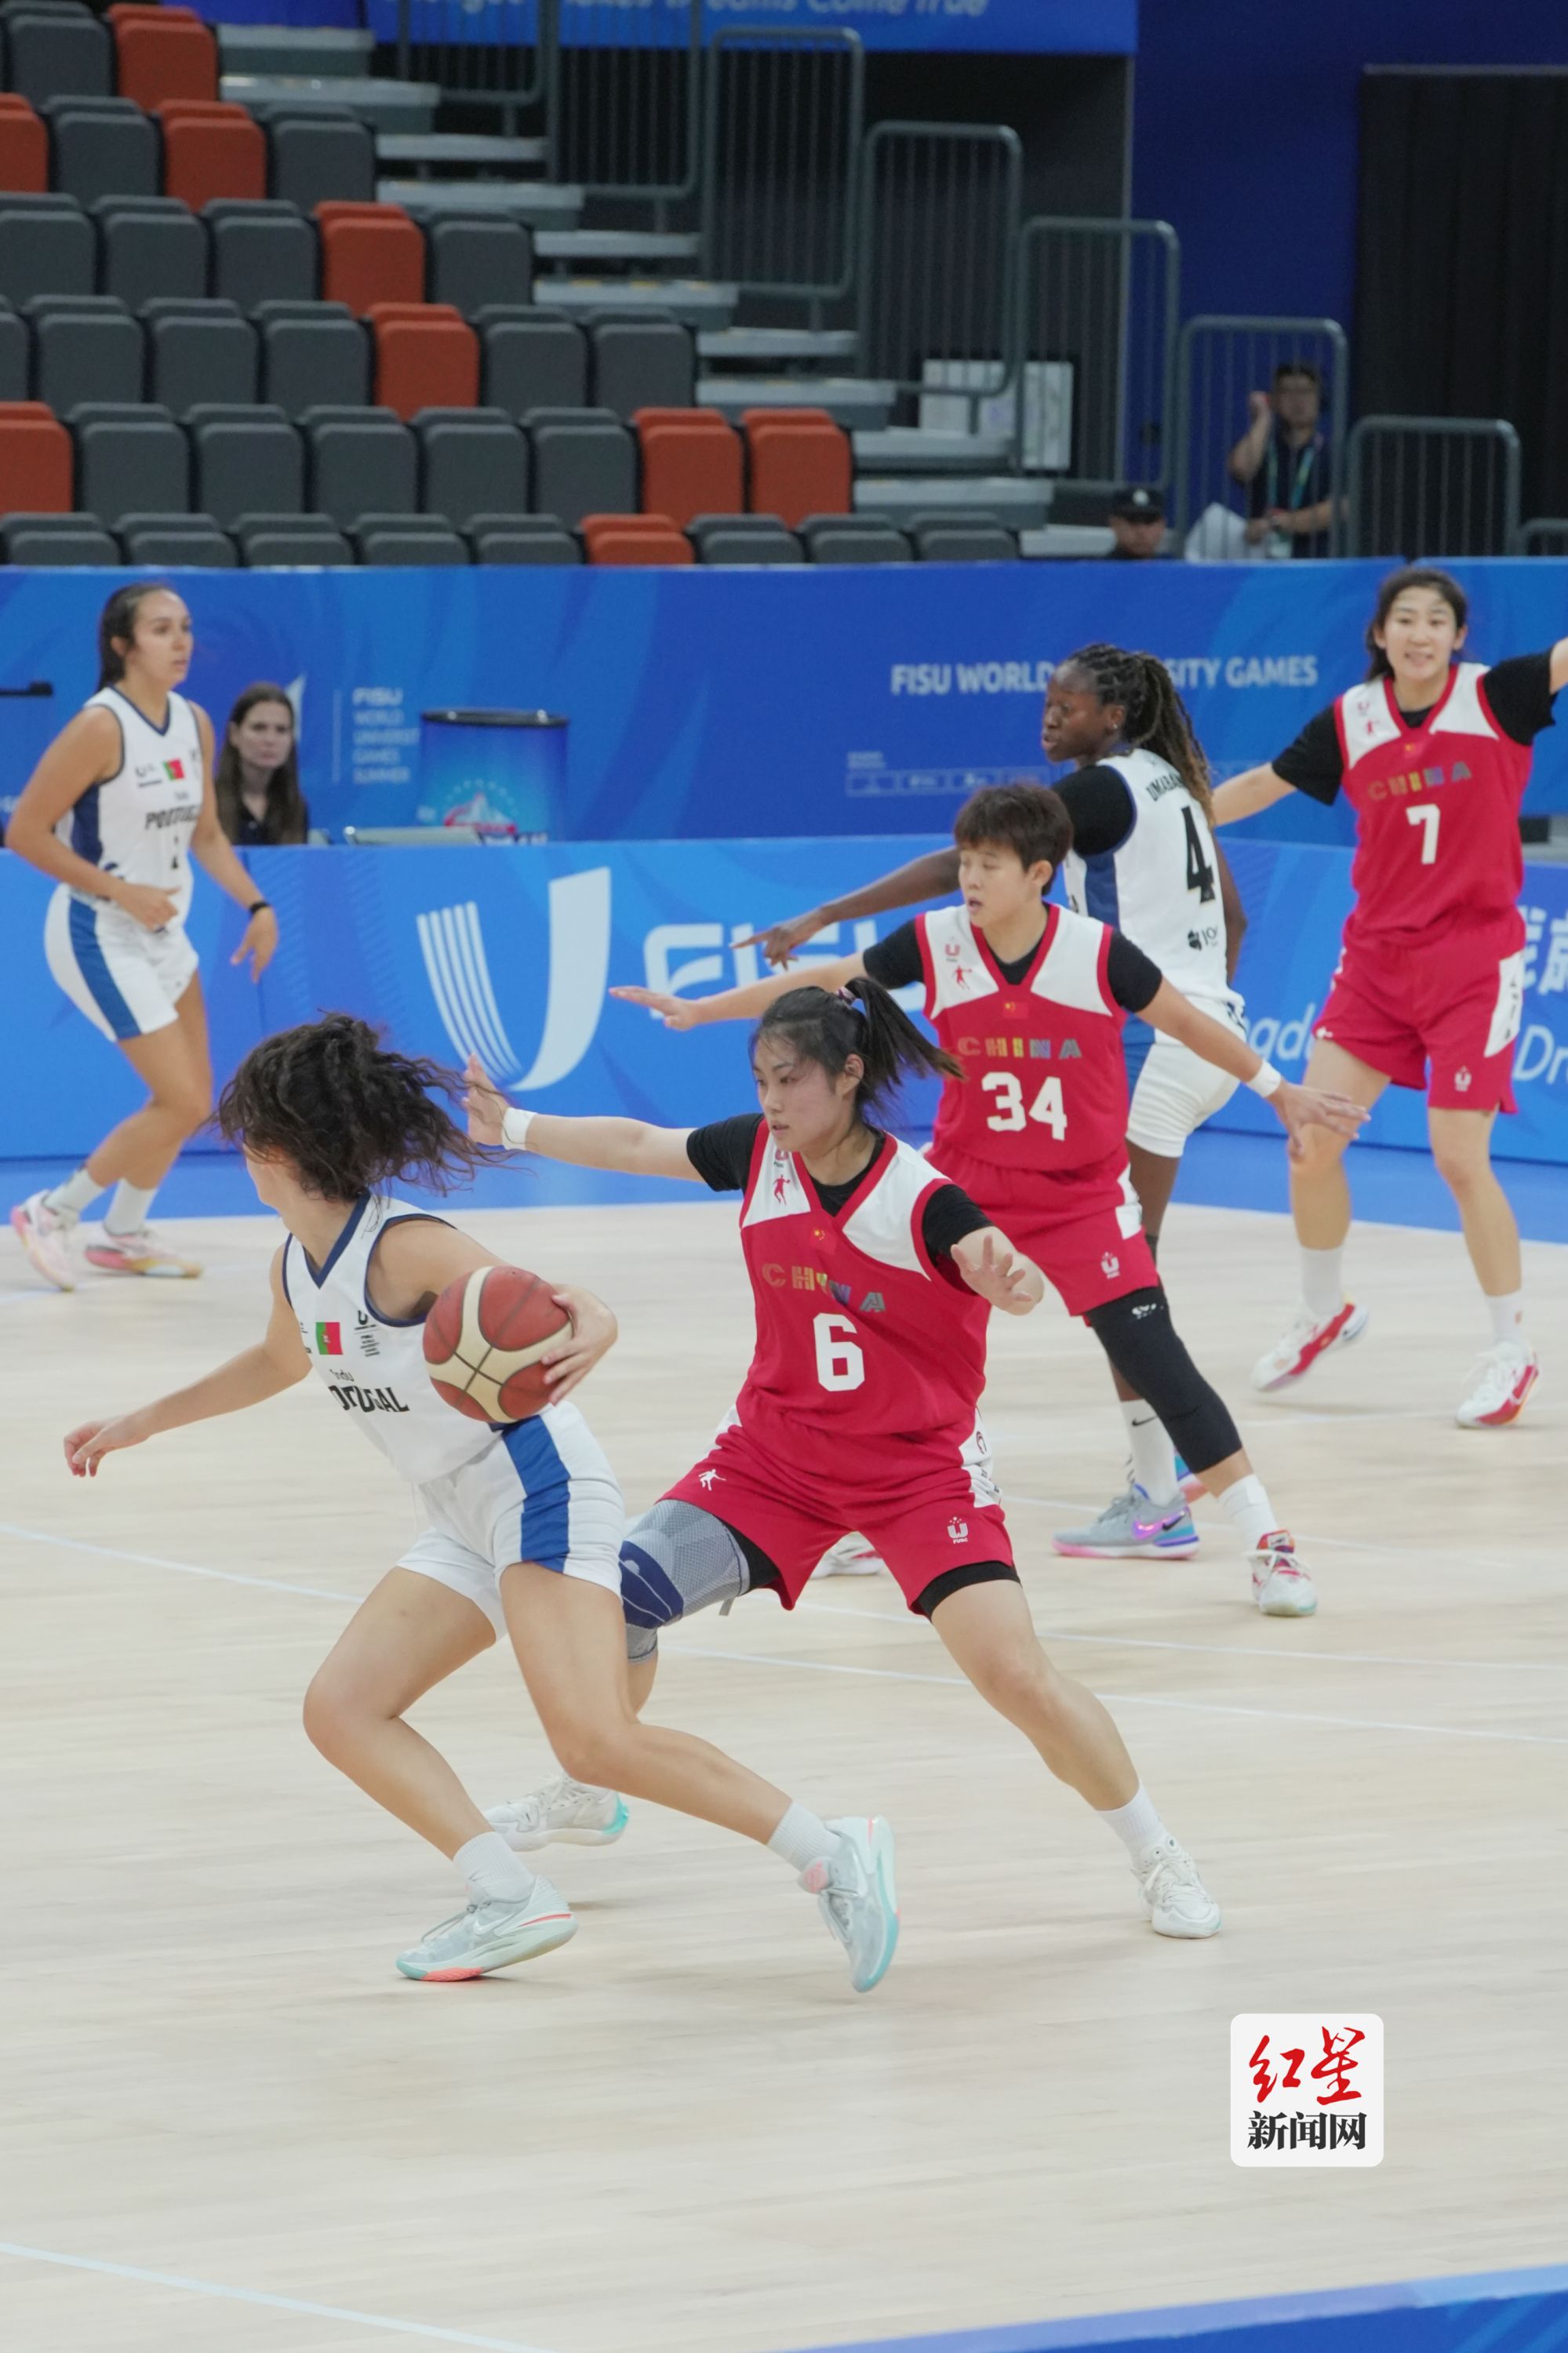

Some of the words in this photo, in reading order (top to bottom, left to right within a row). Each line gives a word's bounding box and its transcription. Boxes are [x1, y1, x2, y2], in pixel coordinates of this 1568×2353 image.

[891, 664, 951, 695] FISU
[956, 661, 1056, 693] WORLD
[1225, 655, 1319, 688] GAMES
[1367, 760, 1472, 801] CHINA
[1180, 806, 1217, 904] 4
[1406, 803, 1441, 865] 7
[956, 1035, 1083, 1060] CHINA
[980, 1071, 1068, 1142] 34
[761, 1262, 887, 1313] CHINA
[812, 1311, 866, 1392] 6
